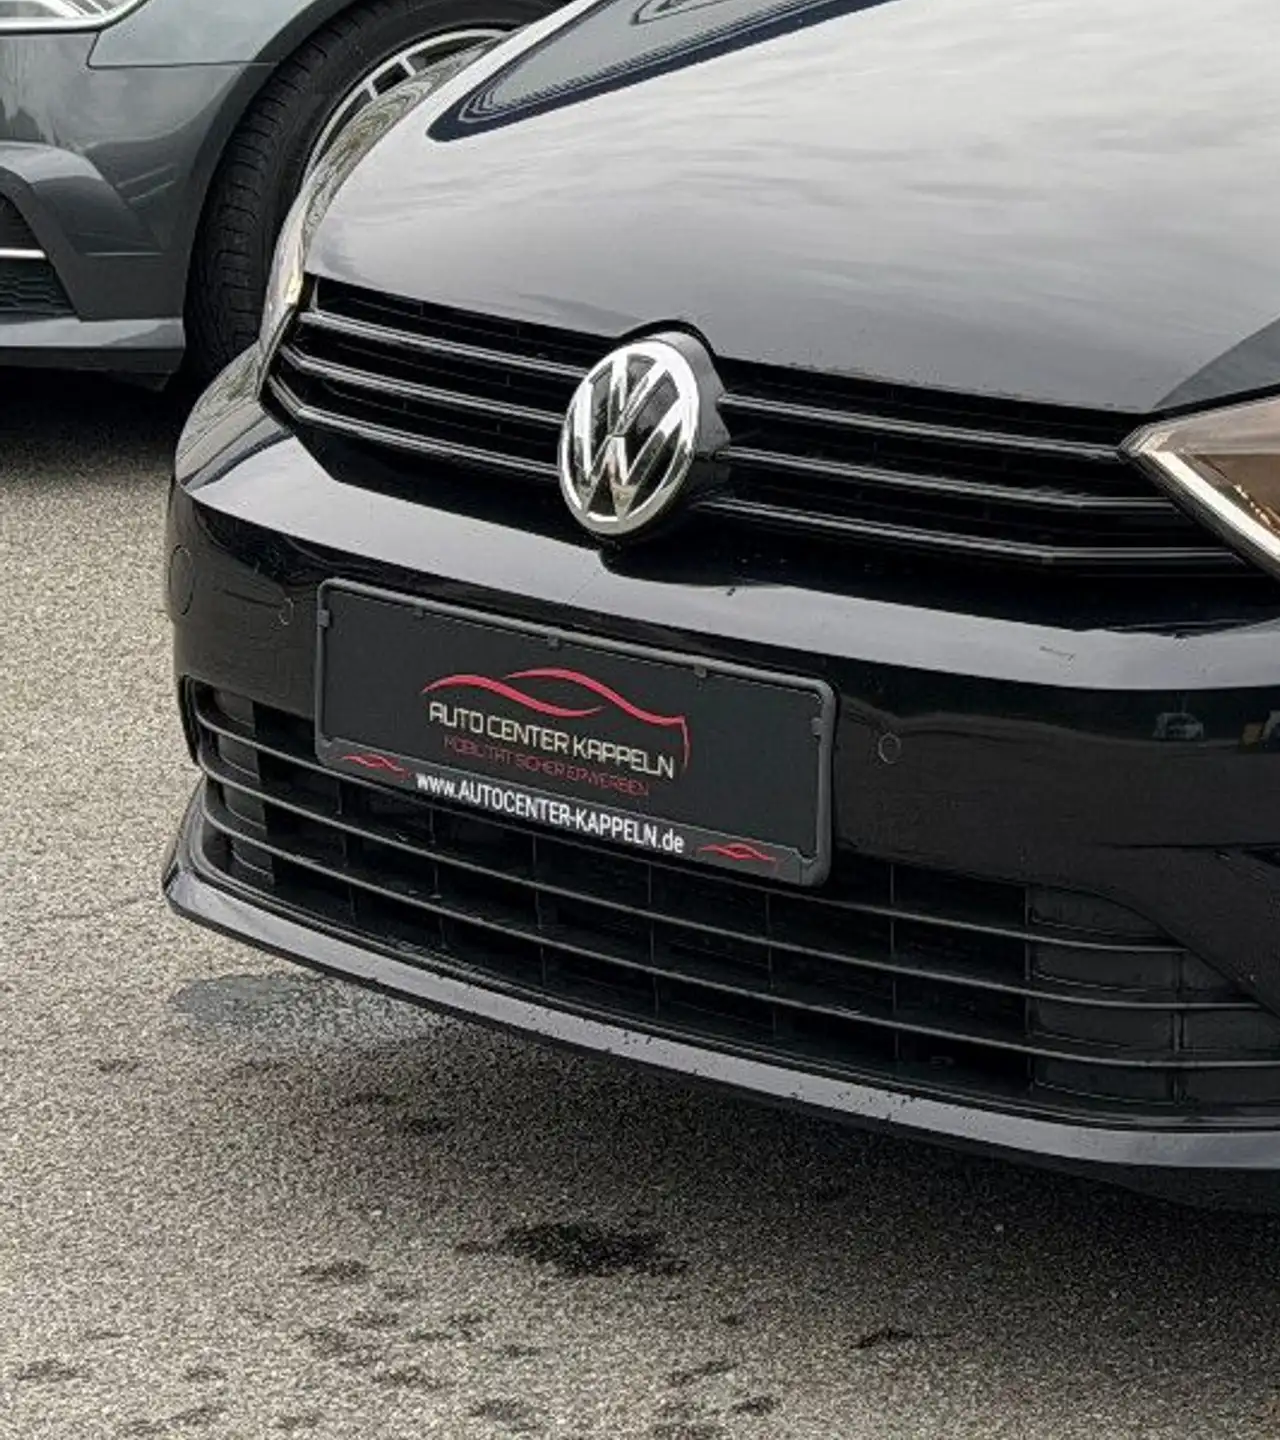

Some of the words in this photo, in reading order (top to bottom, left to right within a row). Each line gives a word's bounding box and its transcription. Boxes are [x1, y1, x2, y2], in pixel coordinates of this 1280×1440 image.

[428, 702, 484, 733] AUTO
[487, 715, 570, 754] CENTER
[572, 735, 675, 779] KAPPELN
[415, 772, 685, 853] www.AUTOCENTER-KAPPELN.de
